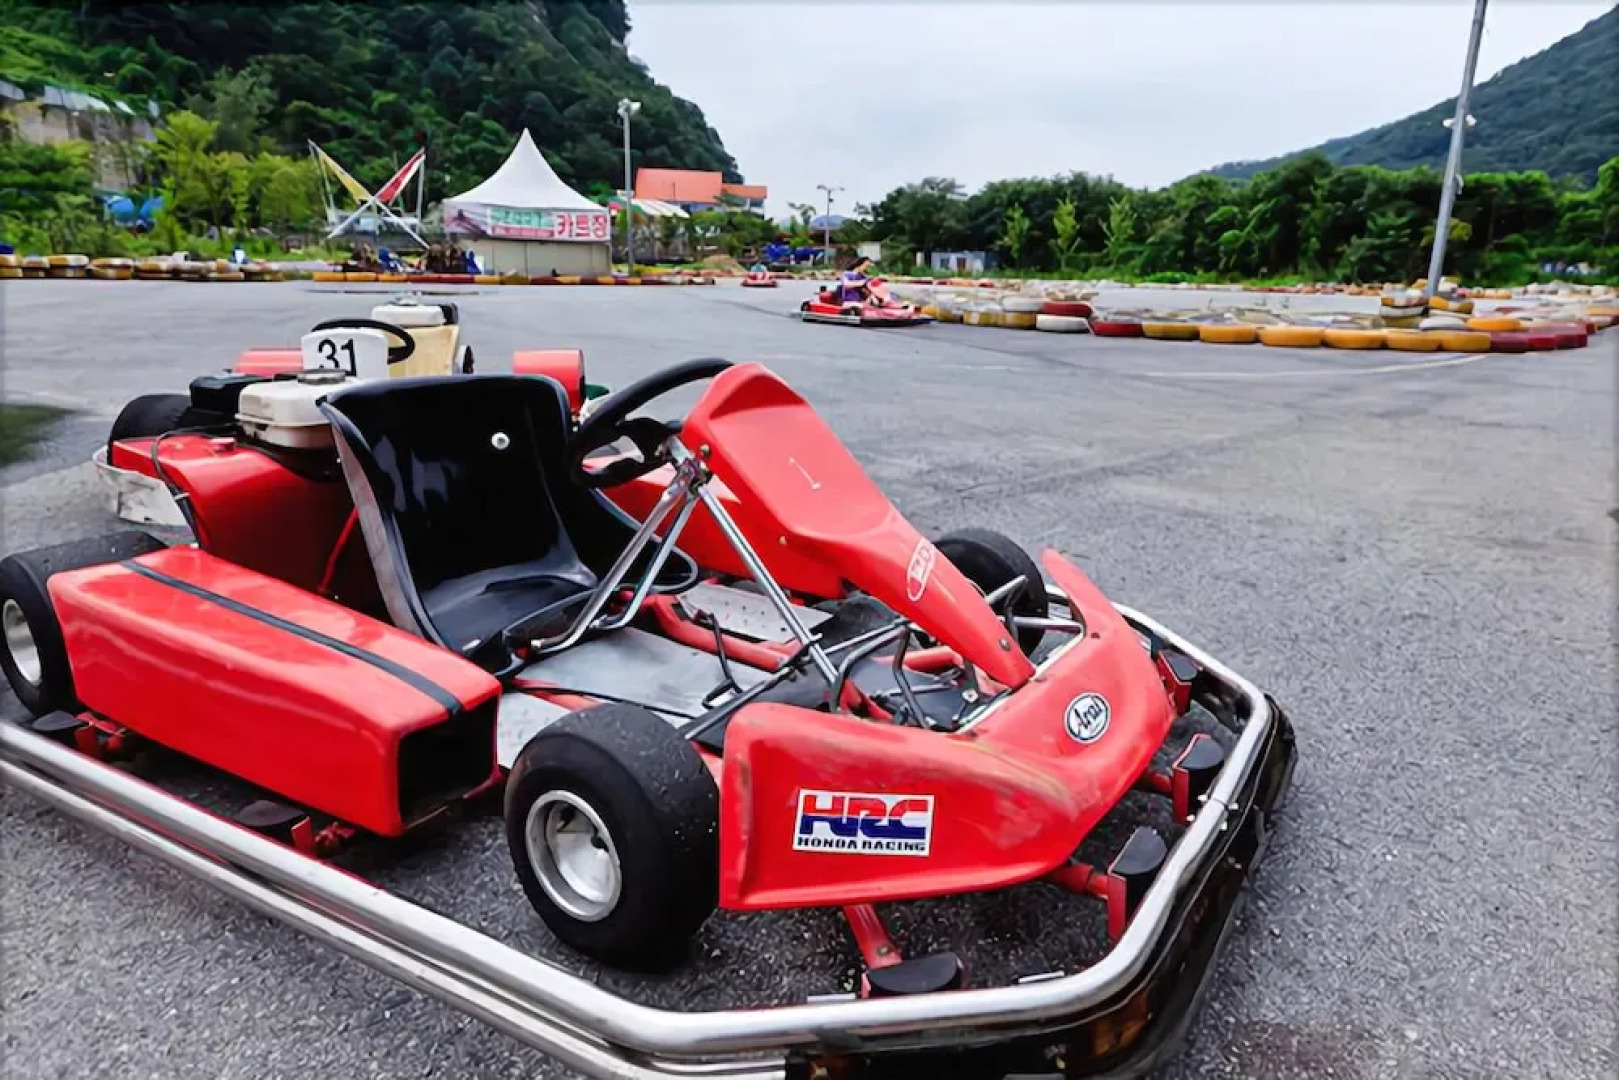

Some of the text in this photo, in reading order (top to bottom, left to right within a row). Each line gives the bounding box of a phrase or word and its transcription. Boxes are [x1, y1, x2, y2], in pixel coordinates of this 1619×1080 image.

[556, 213, 608, 239] 카트장
[318, 337, 357, 377] 31
[799, 795, 928, 839] HRC
[797, 836, 926, 851] HONDA RACING
